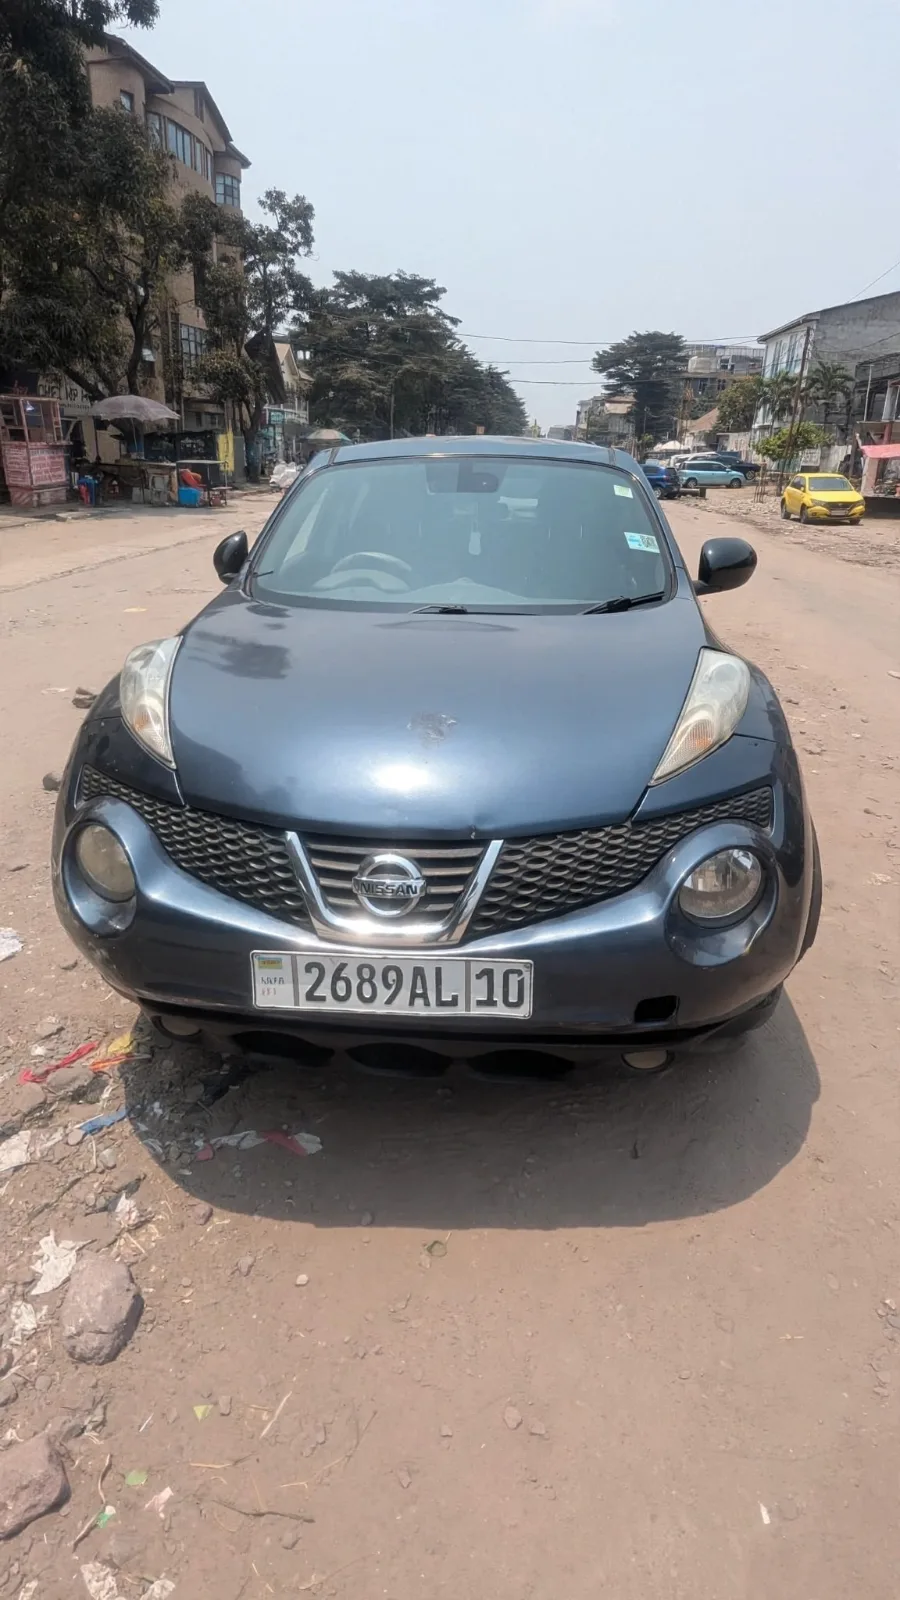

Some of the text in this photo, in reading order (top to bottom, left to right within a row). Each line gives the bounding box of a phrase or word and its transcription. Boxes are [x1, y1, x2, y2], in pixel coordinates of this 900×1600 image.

[360, 882, 418, 895] NISSAN
[304, 961, 524, 1008] 2689AL 10
